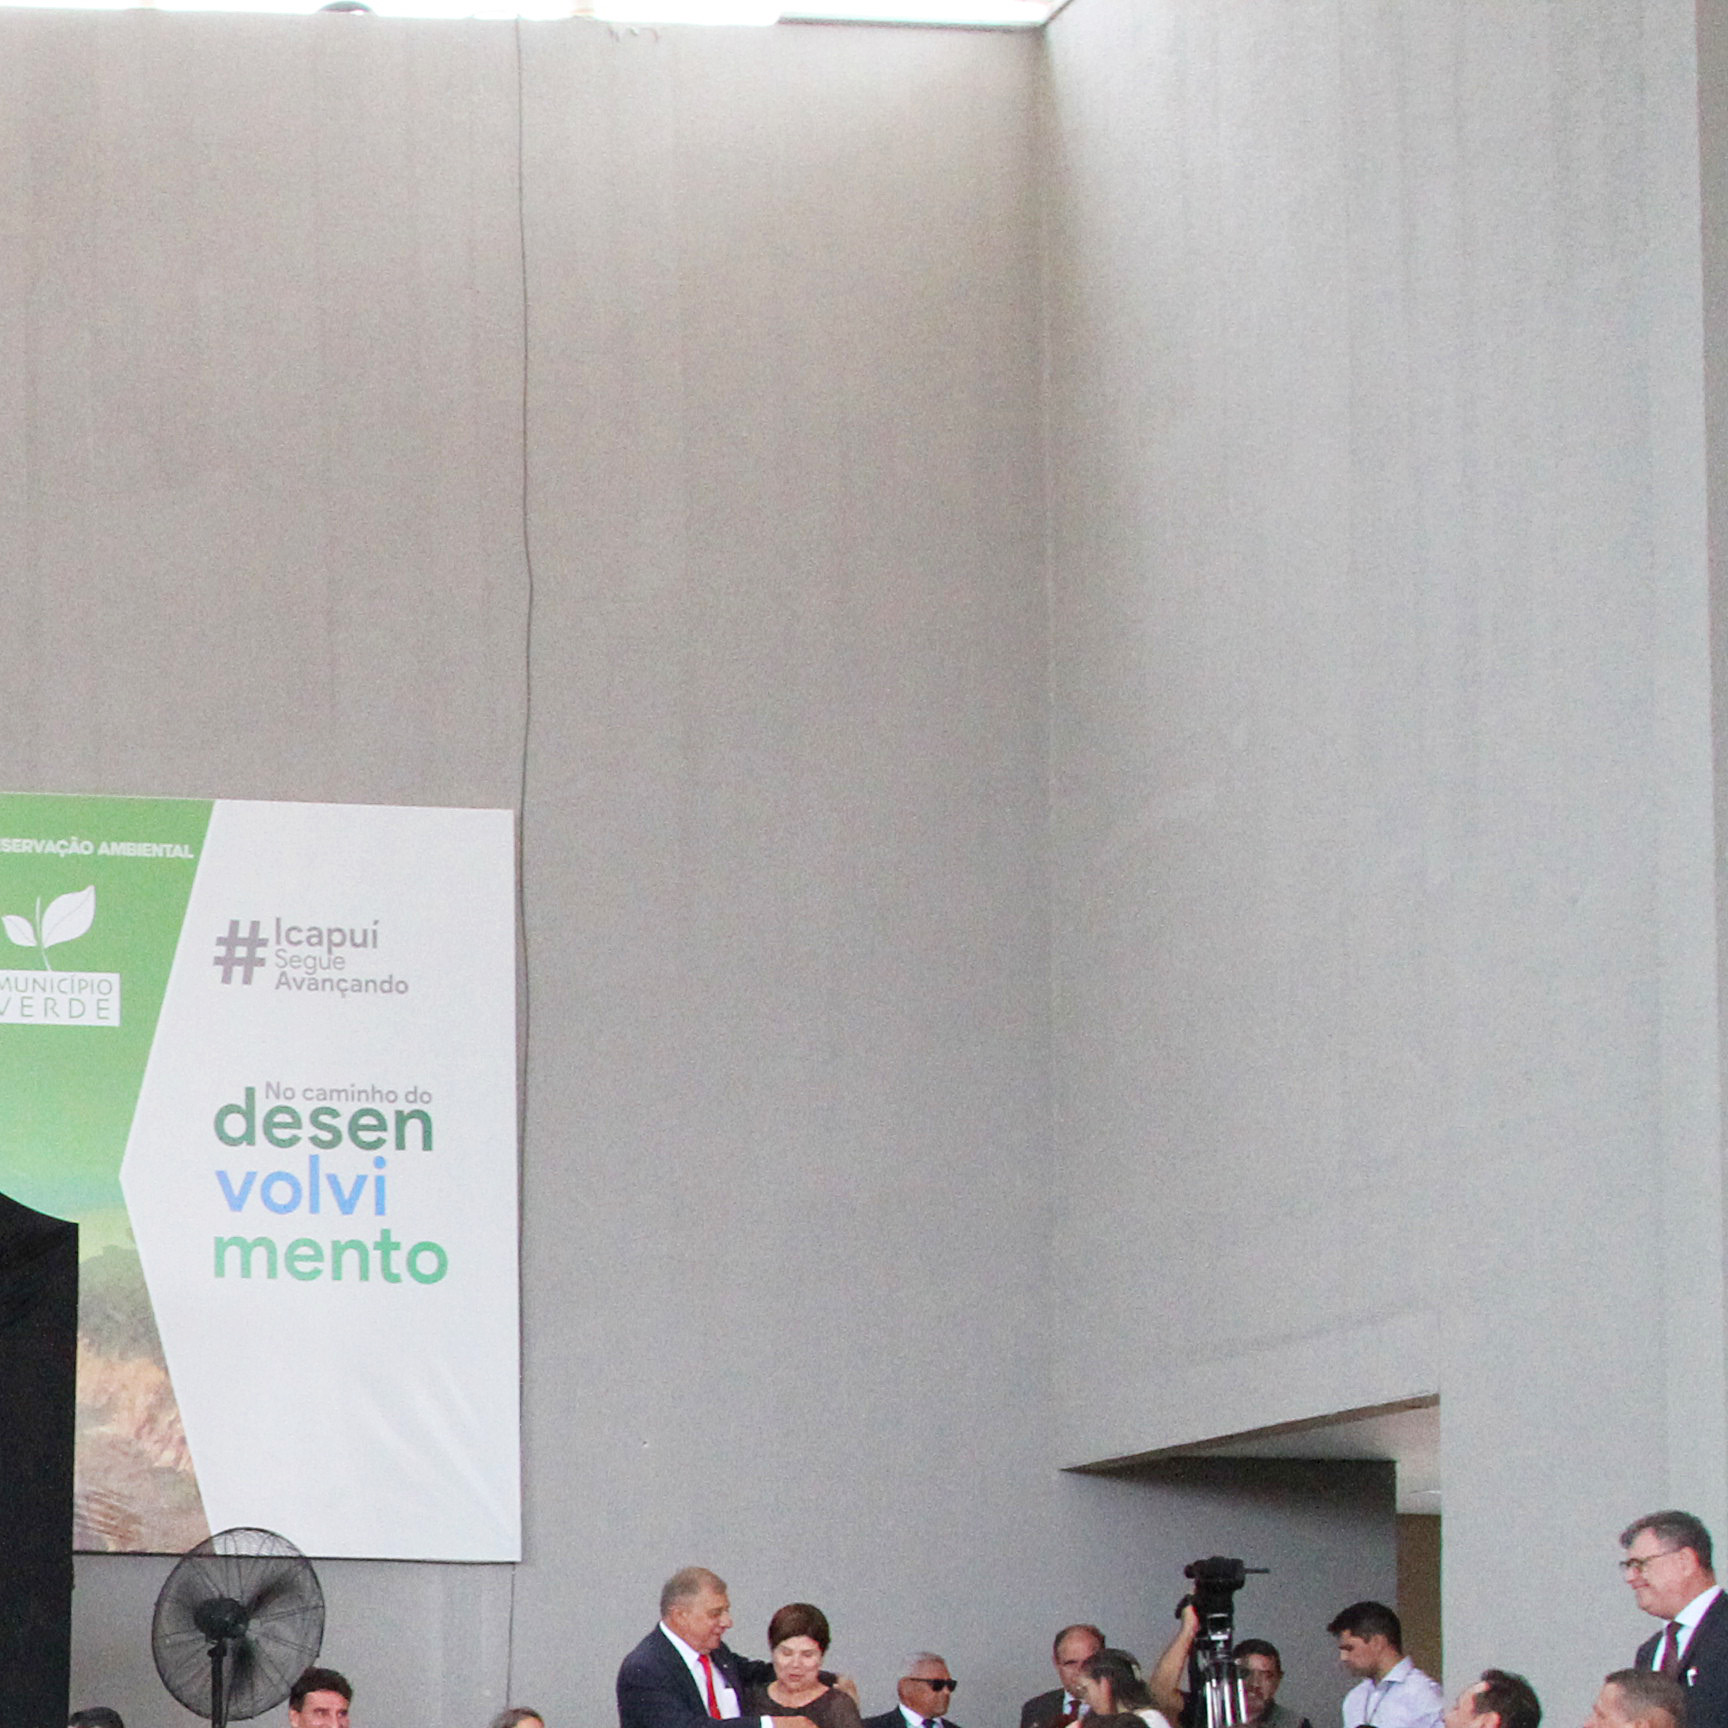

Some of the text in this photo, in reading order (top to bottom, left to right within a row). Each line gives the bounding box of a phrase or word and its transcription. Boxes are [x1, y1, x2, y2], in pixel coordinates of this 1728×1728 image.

[97, 841, 194, 858] AMBIENTAL
[274, 949, 346, 975] Segue
[275, 971, 409, 998] Avançando
[265, 1081, 432, 1104] No caminho do
[214, 1086, 433, 1152] desen
[215, 1154, 387, 1216] volvi
[213, 1228, 449, 1285] mento
